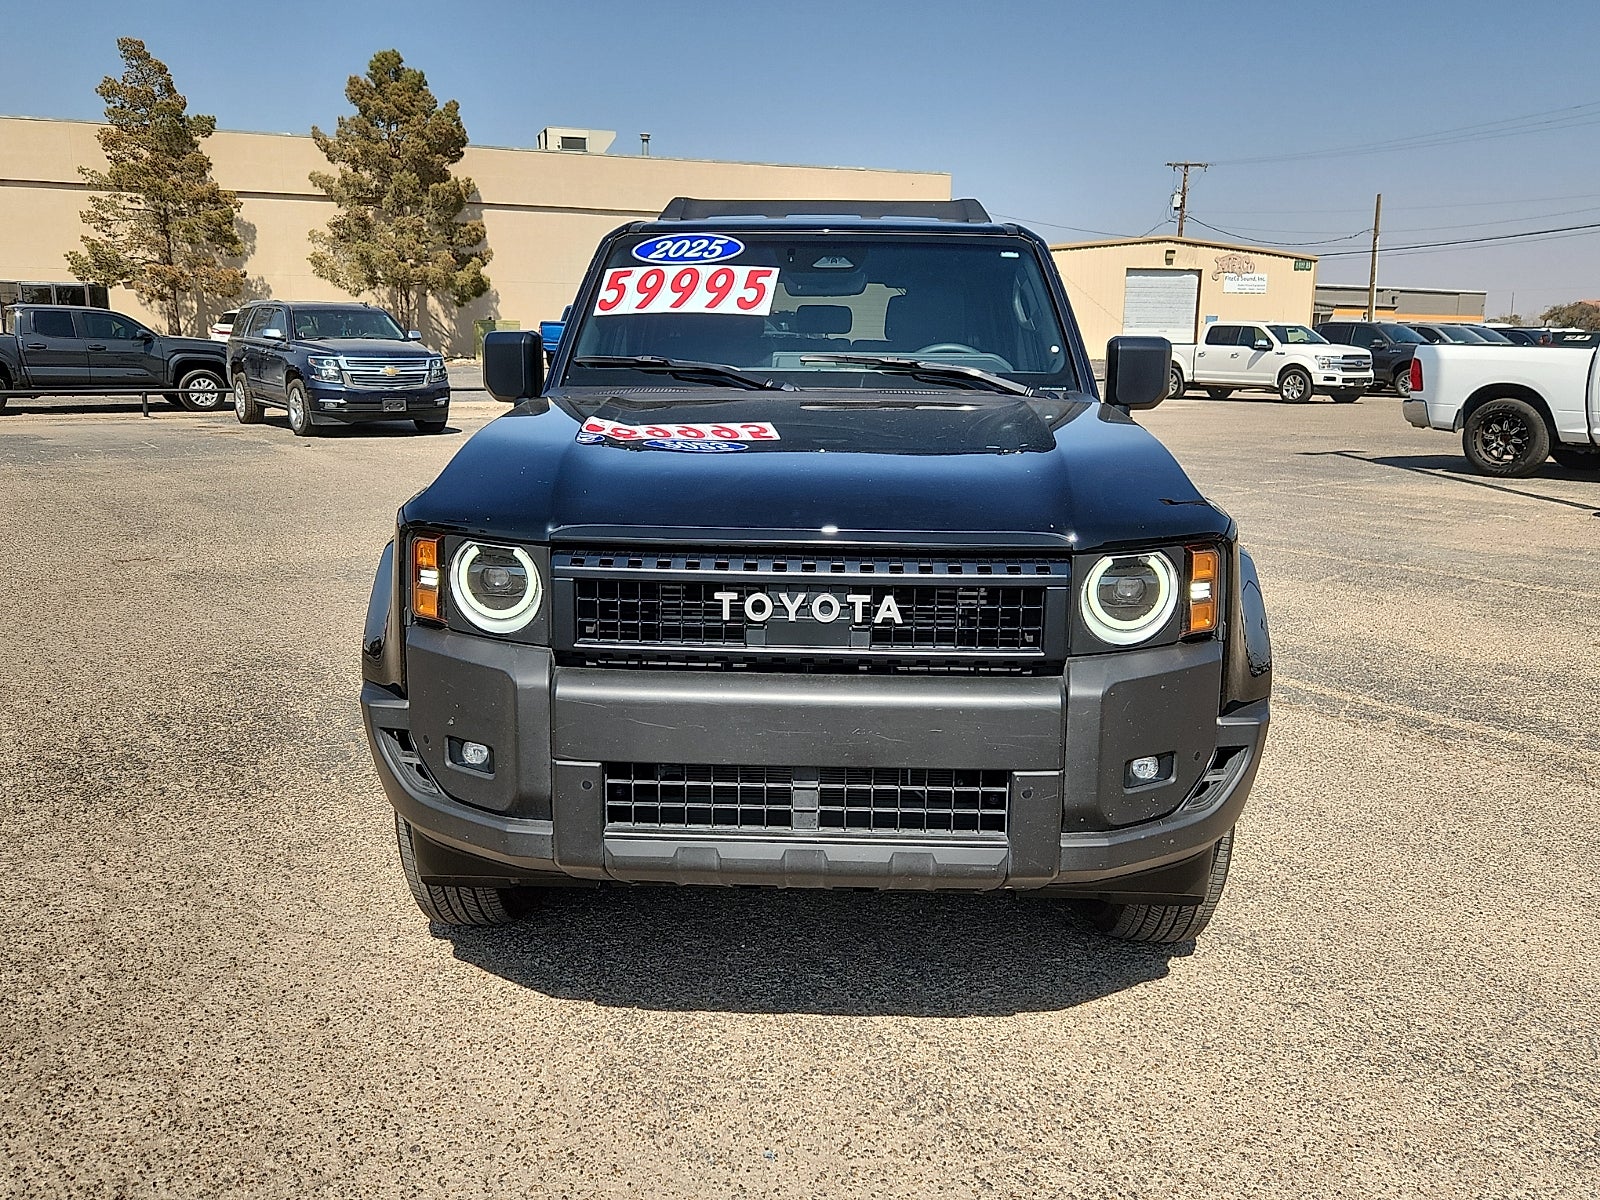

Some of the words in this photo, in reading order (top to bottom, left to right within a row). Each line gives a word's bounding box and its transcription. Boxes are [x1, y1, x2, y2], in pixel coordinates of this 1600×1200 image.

[647, 239, 729, 259] 2025
[598, 267, 774, 311] 59995
[714, 591, 903, 624] TOYOTA
